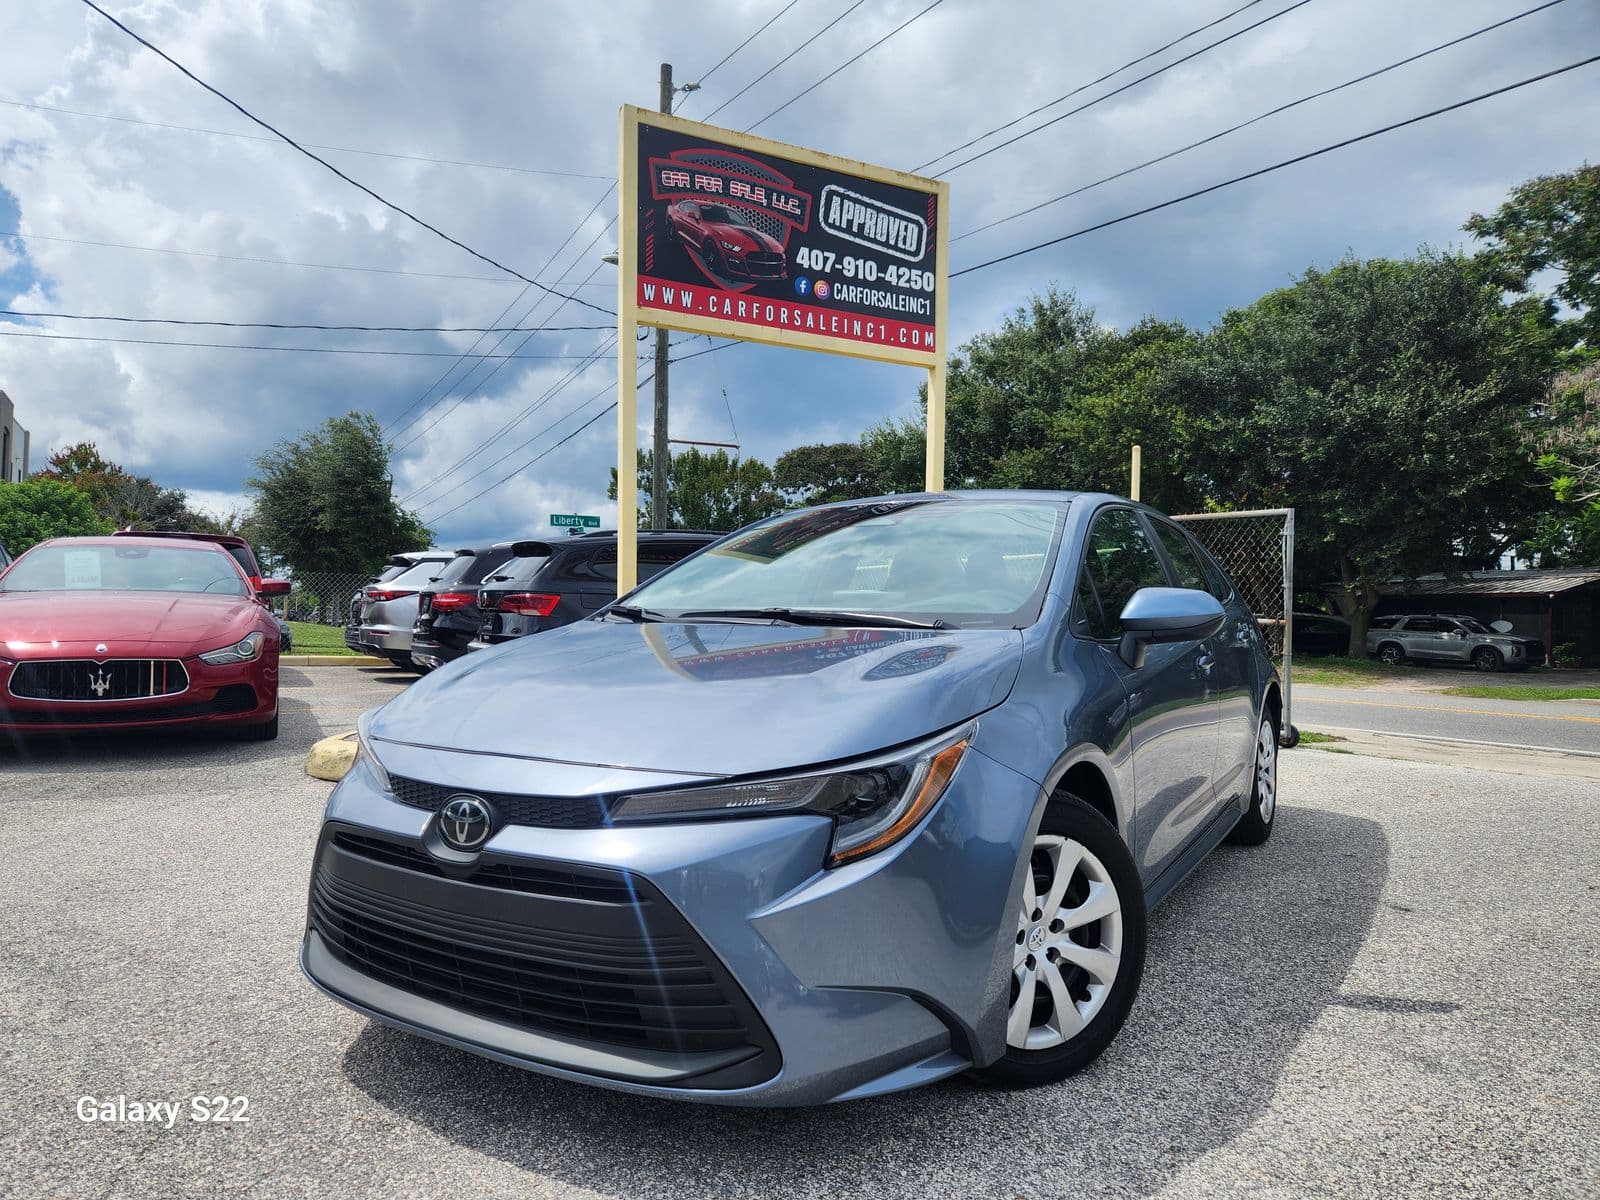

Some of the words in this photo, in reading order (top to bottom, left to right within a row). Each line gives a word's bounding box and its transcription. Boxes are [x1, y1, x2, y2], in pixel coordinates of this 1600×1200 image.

[662, 170, 690, 188] CAR
[695, 174, 723, 193] FOR
[828, 195, 919, 252] APPROVED
[796, 246, 935, 292] 407-910-4250
[833, 282, 930, 316] CARFORSALEINC1
[553, 515, 585, 526] Liberty
